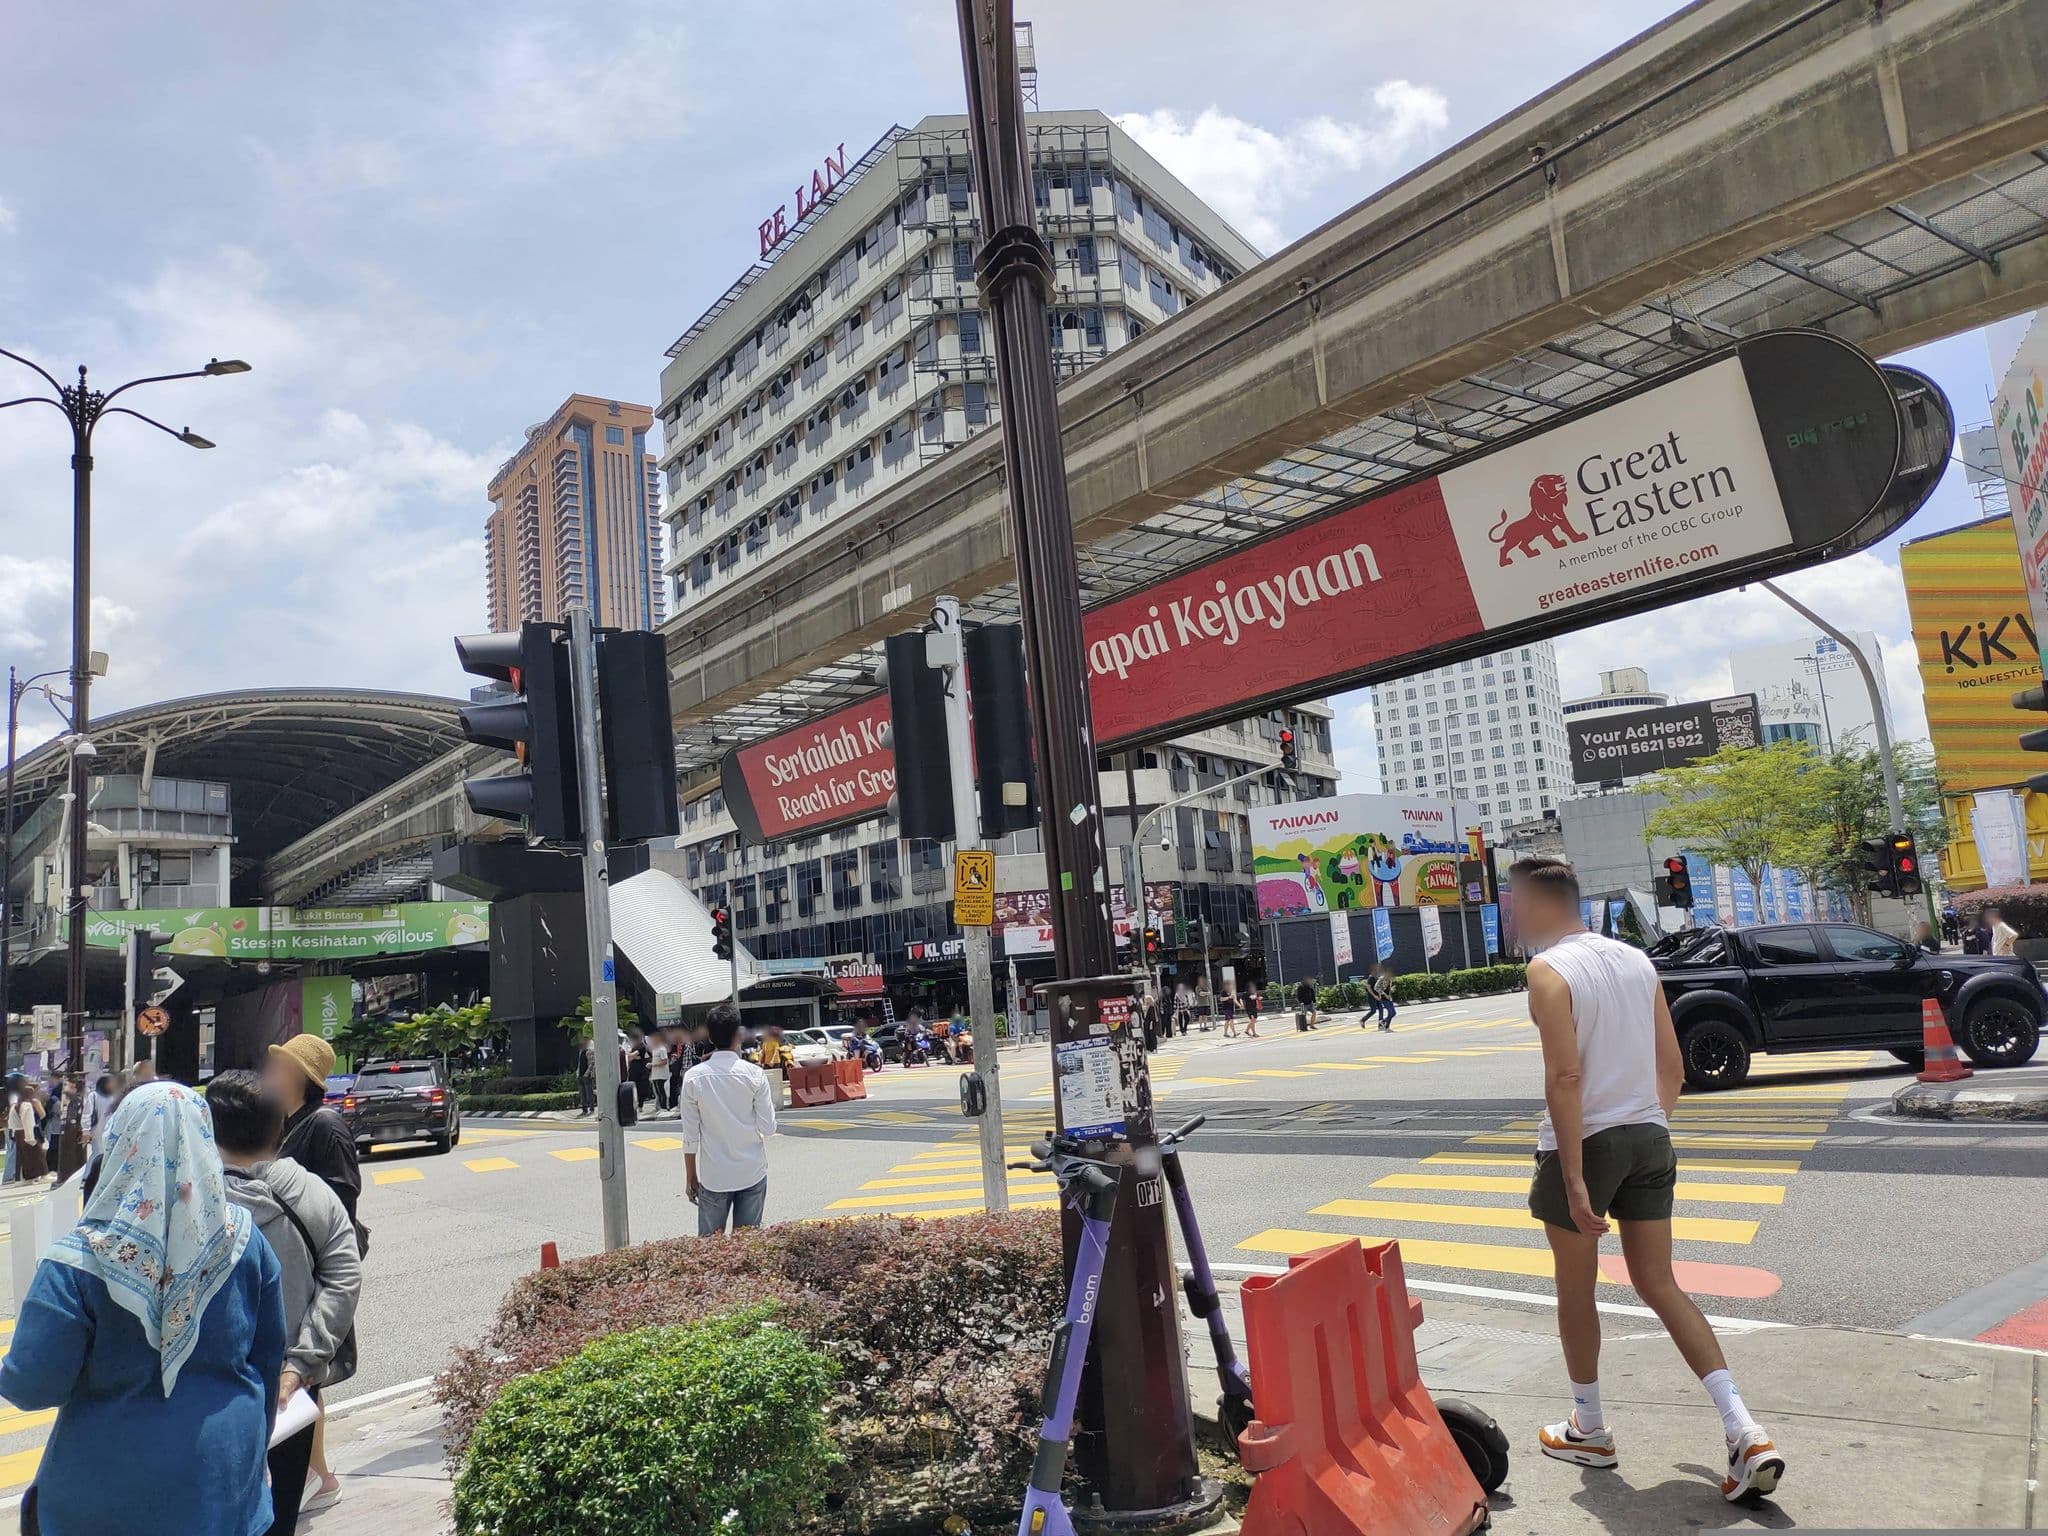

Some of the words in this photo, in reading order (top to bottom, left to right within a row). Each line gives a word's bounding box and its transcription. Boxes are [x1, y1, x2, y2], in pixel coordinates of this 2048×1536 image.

[1577, 431, 1687, 495] Great
[1585, 465, 1737, 537] Eastern
[1559, 559, 1567, 570] A
[1569, 544, 1617, 567] member
[1621, 536, 1634, 550] of
[1637, 530, 1658, 545] the
[1661, 517, 1698, 538] OCBC
[1700, 504, 1743, 525] Group
[1538, 544, 1719, 610] greateasternlife.com
[1088, 605, 1170, 680] apai
[1168, 543, 1382, 647] Kejayaan
[1957, 679, 1977, 688] 100
[1580, 730, 1621, 746] Your
[1625, 724, 1649, 740] Ad
[1652, 716, 1700, 735] Here!
[764, 726, 862, 787] Sertailah
[1598, 744, 1628, 759] 6011
[1631, 739, 1664, 754] 5621
[1667, 733, 1704, 749] 5922
[777, 783, 831, 822] Reach
[829, 777, 855, 806] for
[858, 767, 896, 797] Gre
[1269, 811, 1339, 830] TAIWAN
[1402, 809, 1443, 821] TAIWAN
[1427, 862, 1440, 873] JOM
[295, 910, 322, 921] Bukit
[324, 910, 364, 922] Bintang
[231, 937, 287, 950] Stesen
[292, 933, 367, 948] Kesihatan
[924, 943, 940, 958] KL
[823, 962, 883, 979] AL-SULTAN
[1076, 1274, 1099, 1324] beam
